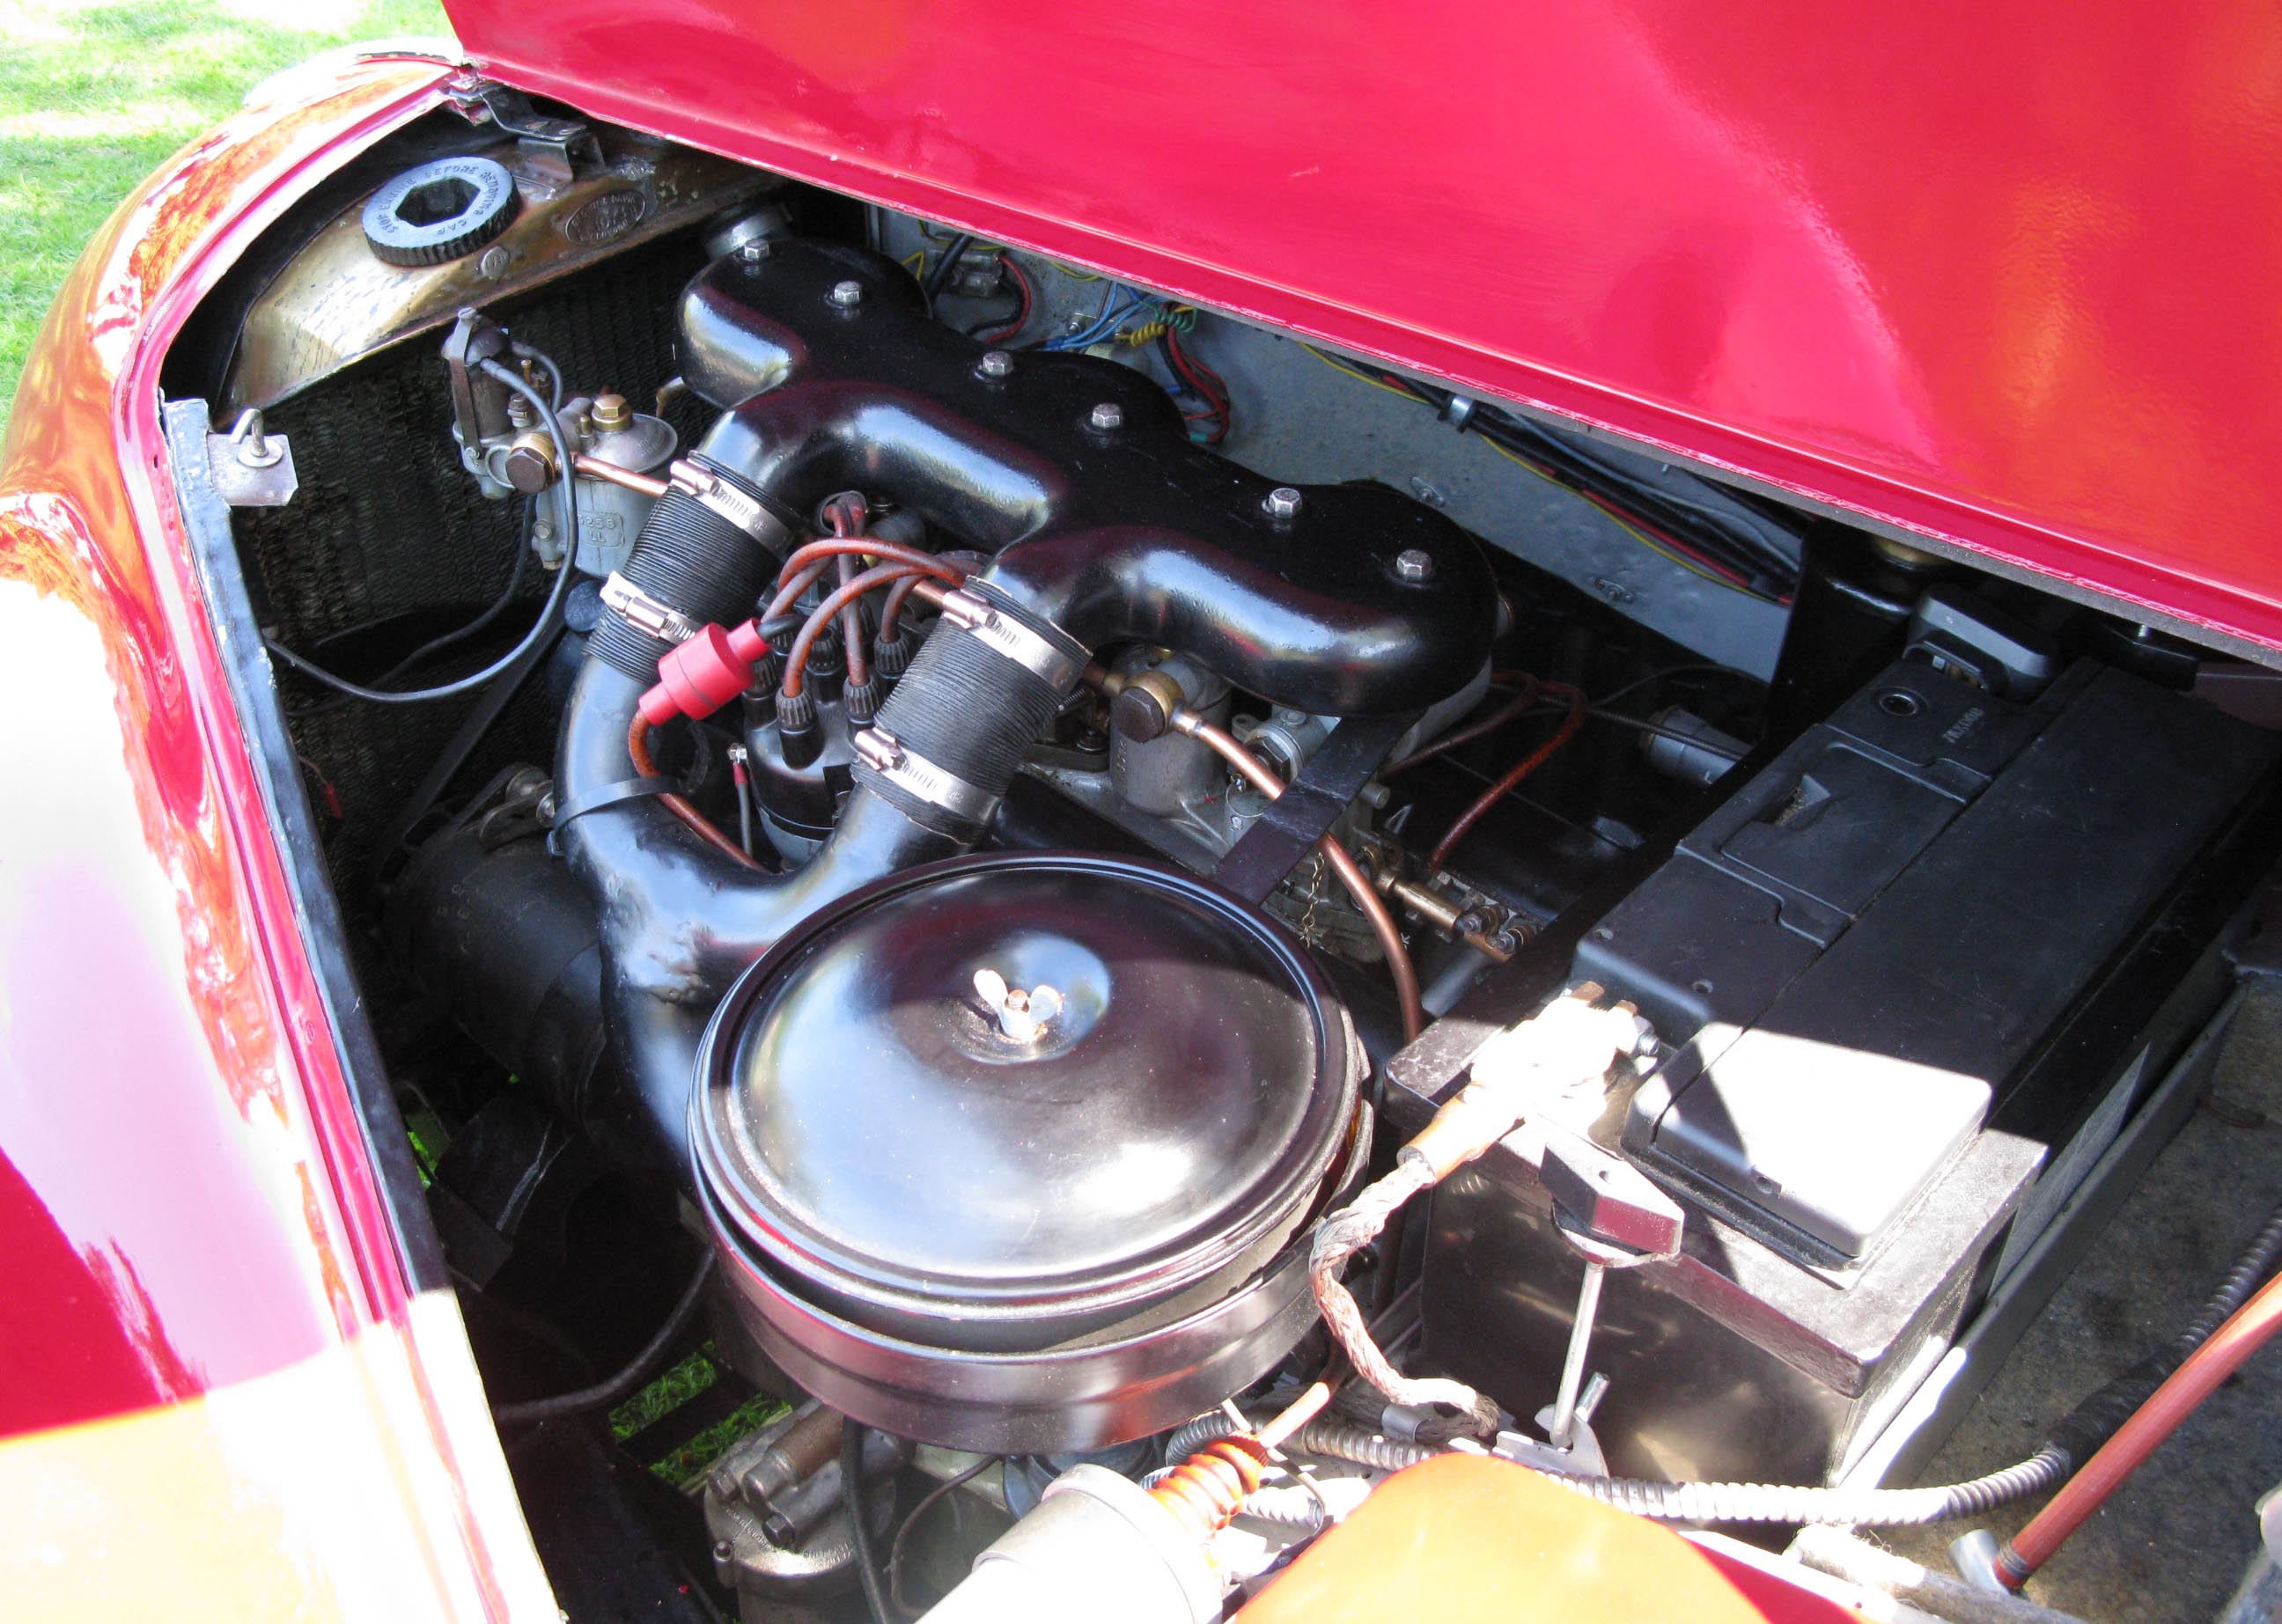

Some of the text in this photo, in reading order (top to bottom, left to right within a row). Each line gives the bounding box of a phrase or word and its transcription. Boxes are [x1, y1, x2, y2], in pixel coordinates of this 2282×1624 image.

[378, 165, 499, 235] STOP ENGINE BEFORE REMOVING CAP
